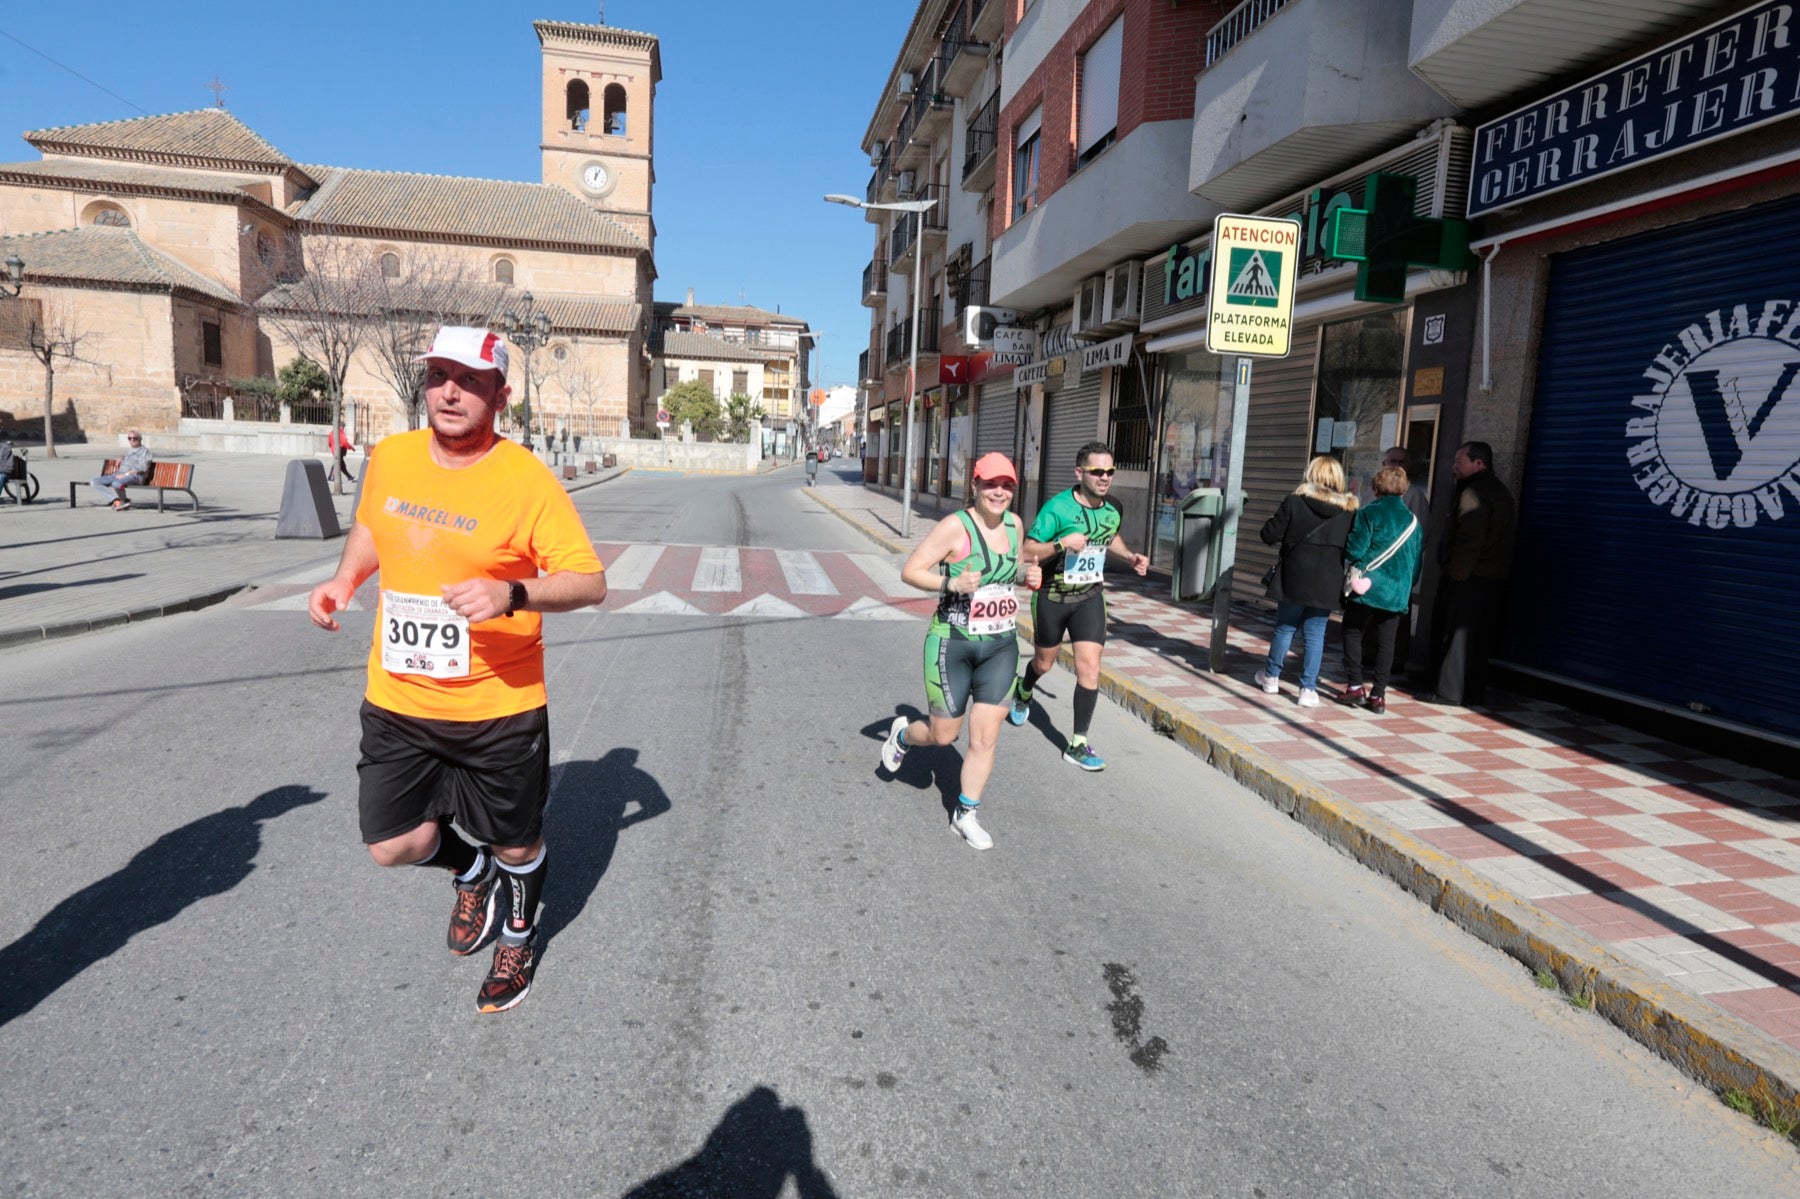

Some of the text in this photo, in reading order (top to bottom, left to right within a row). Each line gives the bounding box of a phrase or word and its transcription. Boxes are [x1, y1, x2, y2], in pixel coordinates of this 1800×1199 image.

[1222, 226, 1295, 245] ATENCION
[1214, 312, 1287, 329] PLATAFORMA
[1012, 342, 1032, 351] BAR
[1224, 331, 1274, 346] ELEVADA
[1085, 346, 1110, 367] LIMA
[1078, 556, 1095, 572] 26
[972, 598, 1017, 618] 2069
[388, 617, 460, 650] 3079
